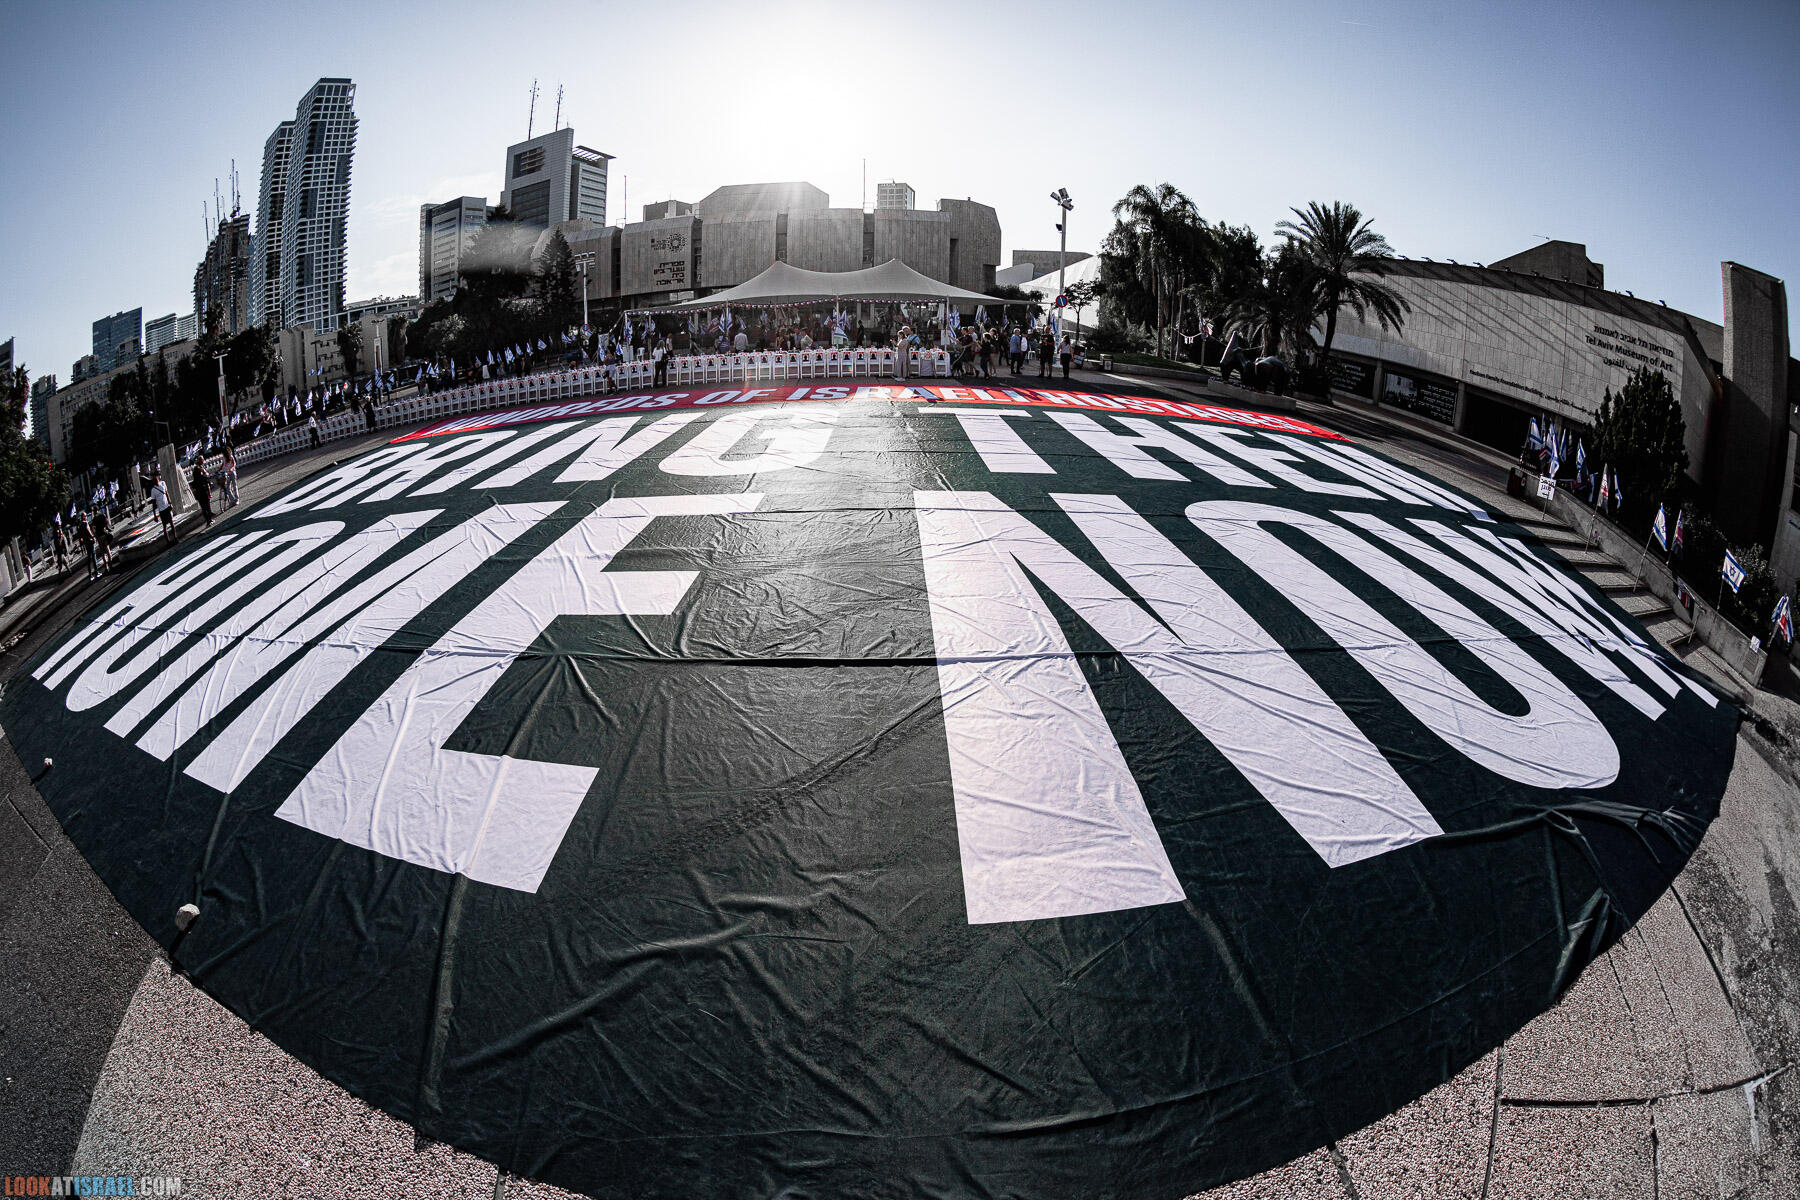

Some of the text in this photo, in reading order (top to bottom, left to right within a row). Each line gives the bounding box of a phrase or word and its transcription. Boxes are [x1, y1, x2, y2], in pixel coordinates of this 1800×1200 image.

[1585, 335, 1673, 372] Tel Aviv Museum of Art
[1620, 332, 1637, 345] אביב
[1638, 336, 1648, 349] תל
[421, 393, 690, 435] HUNDREDS
[694, 388, 777, 405] OF
[786, 386, 1031, 403] ISRAELI
[242, 407, 1498, 524] BRING THEM
[31, 492, 766, 893] HOME
